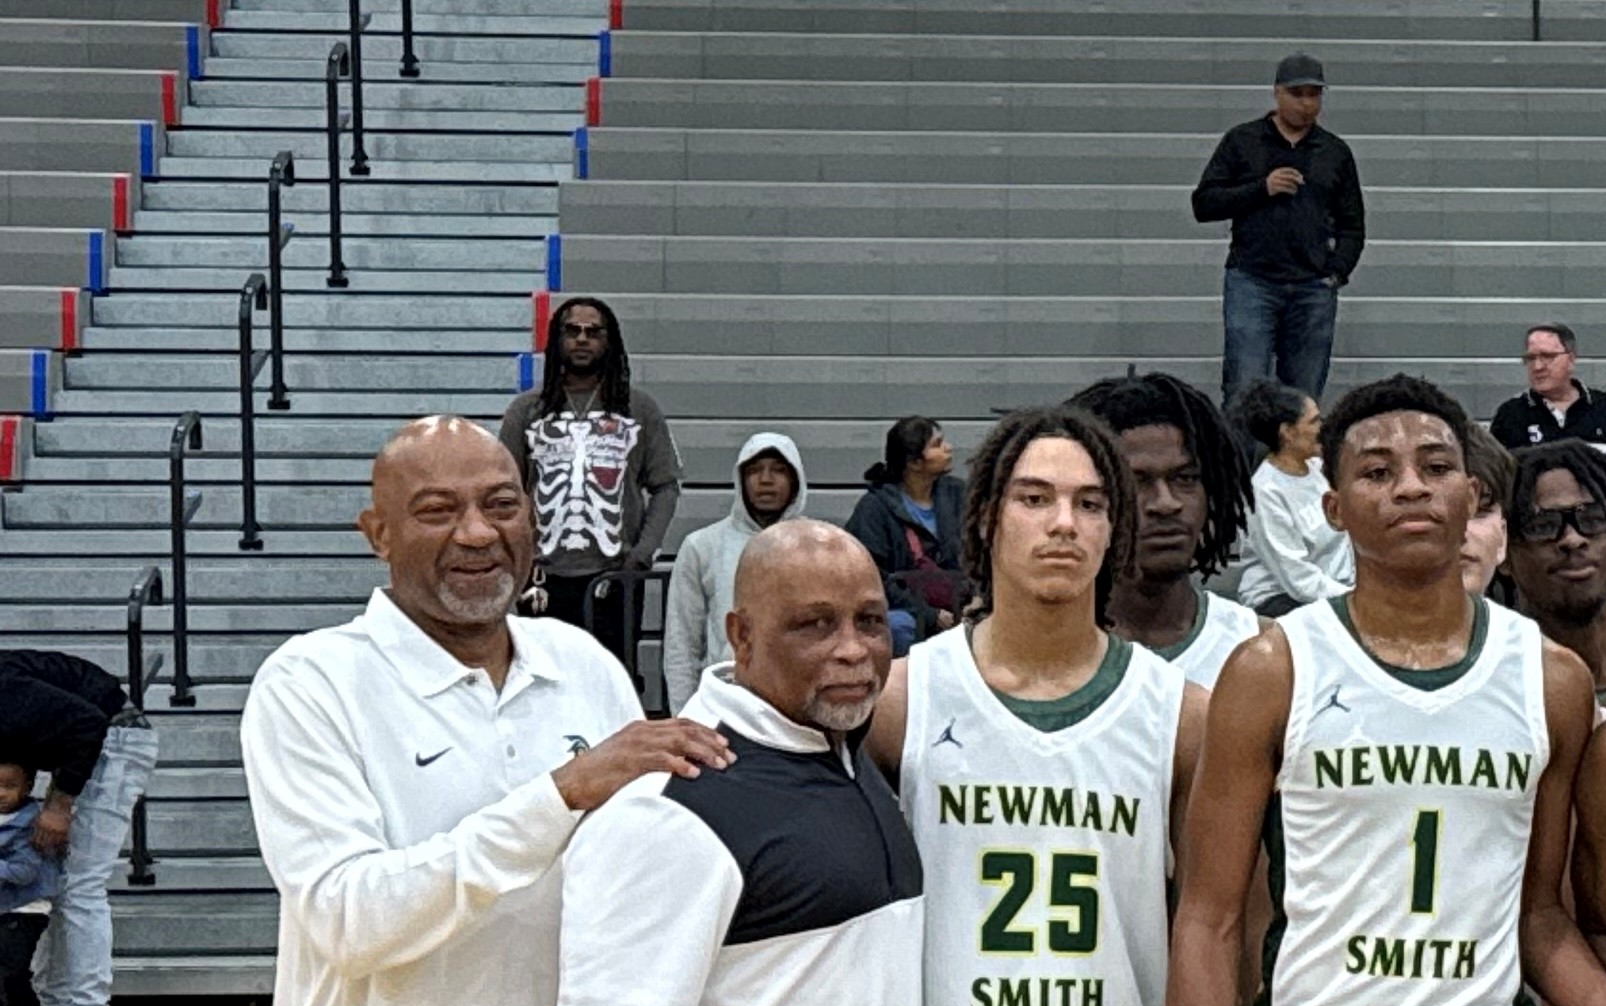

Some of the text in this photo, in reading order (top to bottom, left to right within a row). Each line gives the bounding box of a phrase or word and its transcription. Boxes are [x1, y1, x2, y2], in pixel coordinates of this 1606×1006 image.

[1314, 745, 1533, 793] NEWMAN
[938, 784, 1141, 838] NEWMAN
[1408, 806, 1443, 918] 1
[978, 845, 1103, 958] 25
[1346, 935, 1478, 980] SMITH
